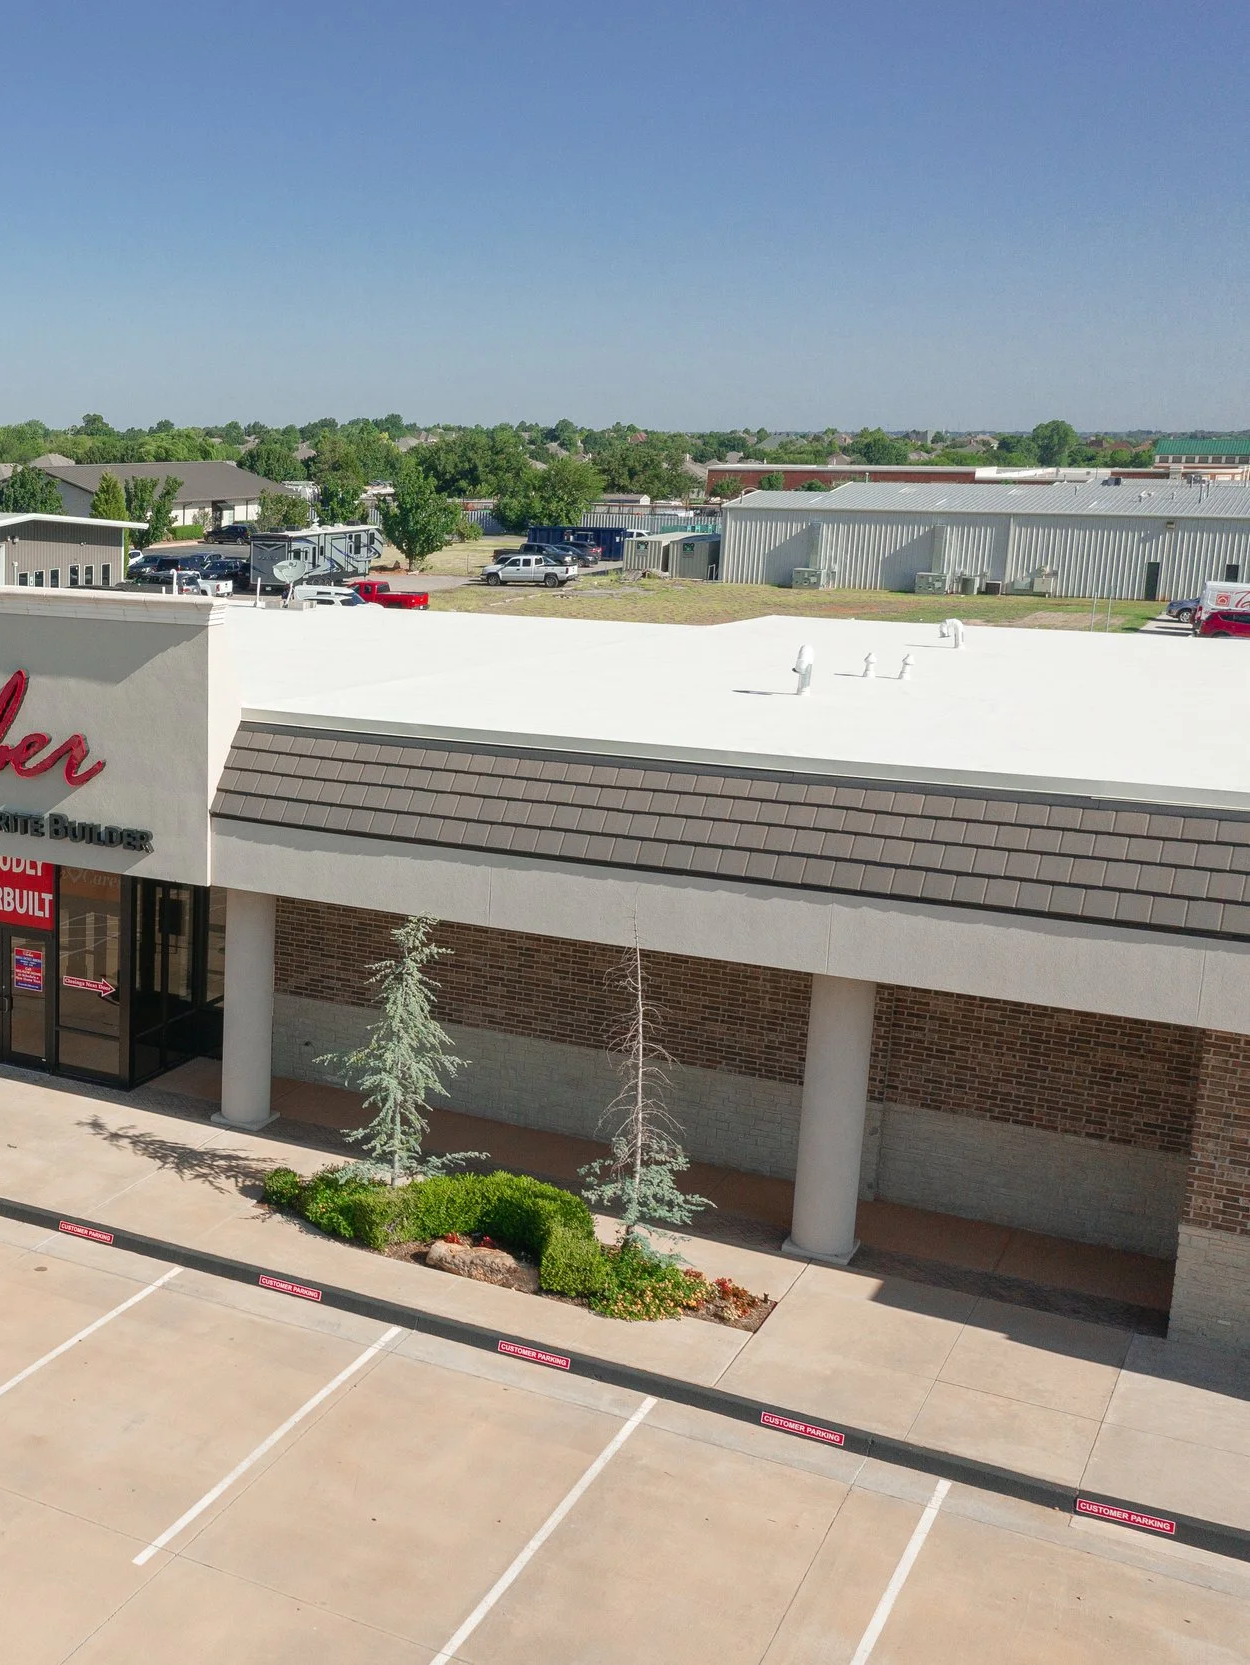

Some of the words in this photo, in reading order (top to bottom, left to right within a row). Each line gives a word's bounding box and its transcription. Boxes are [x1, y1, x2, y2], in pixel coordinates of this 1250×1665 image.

[49, 812, 155, 854] BUILDER
[61, 1223, 89, 1235] CUSTOMER
[88, 1230, 111, 1241] PARKING
[261, 1278, 293, 1290] CUSTOMER
[293, 1286, 318, 1298] PARKING
[500, 1343, 537, 1358] CUSTOMER
[537, 1353, 567, 1366] PARKING
[763, 1415, 806, 1432] CUSTOMER
[806, 1427, 840, 1442] PARKING
[1080, 1502, 1129, 1520] CUSTOMER
[1130, 1514, 1171, 1531] PARKING
